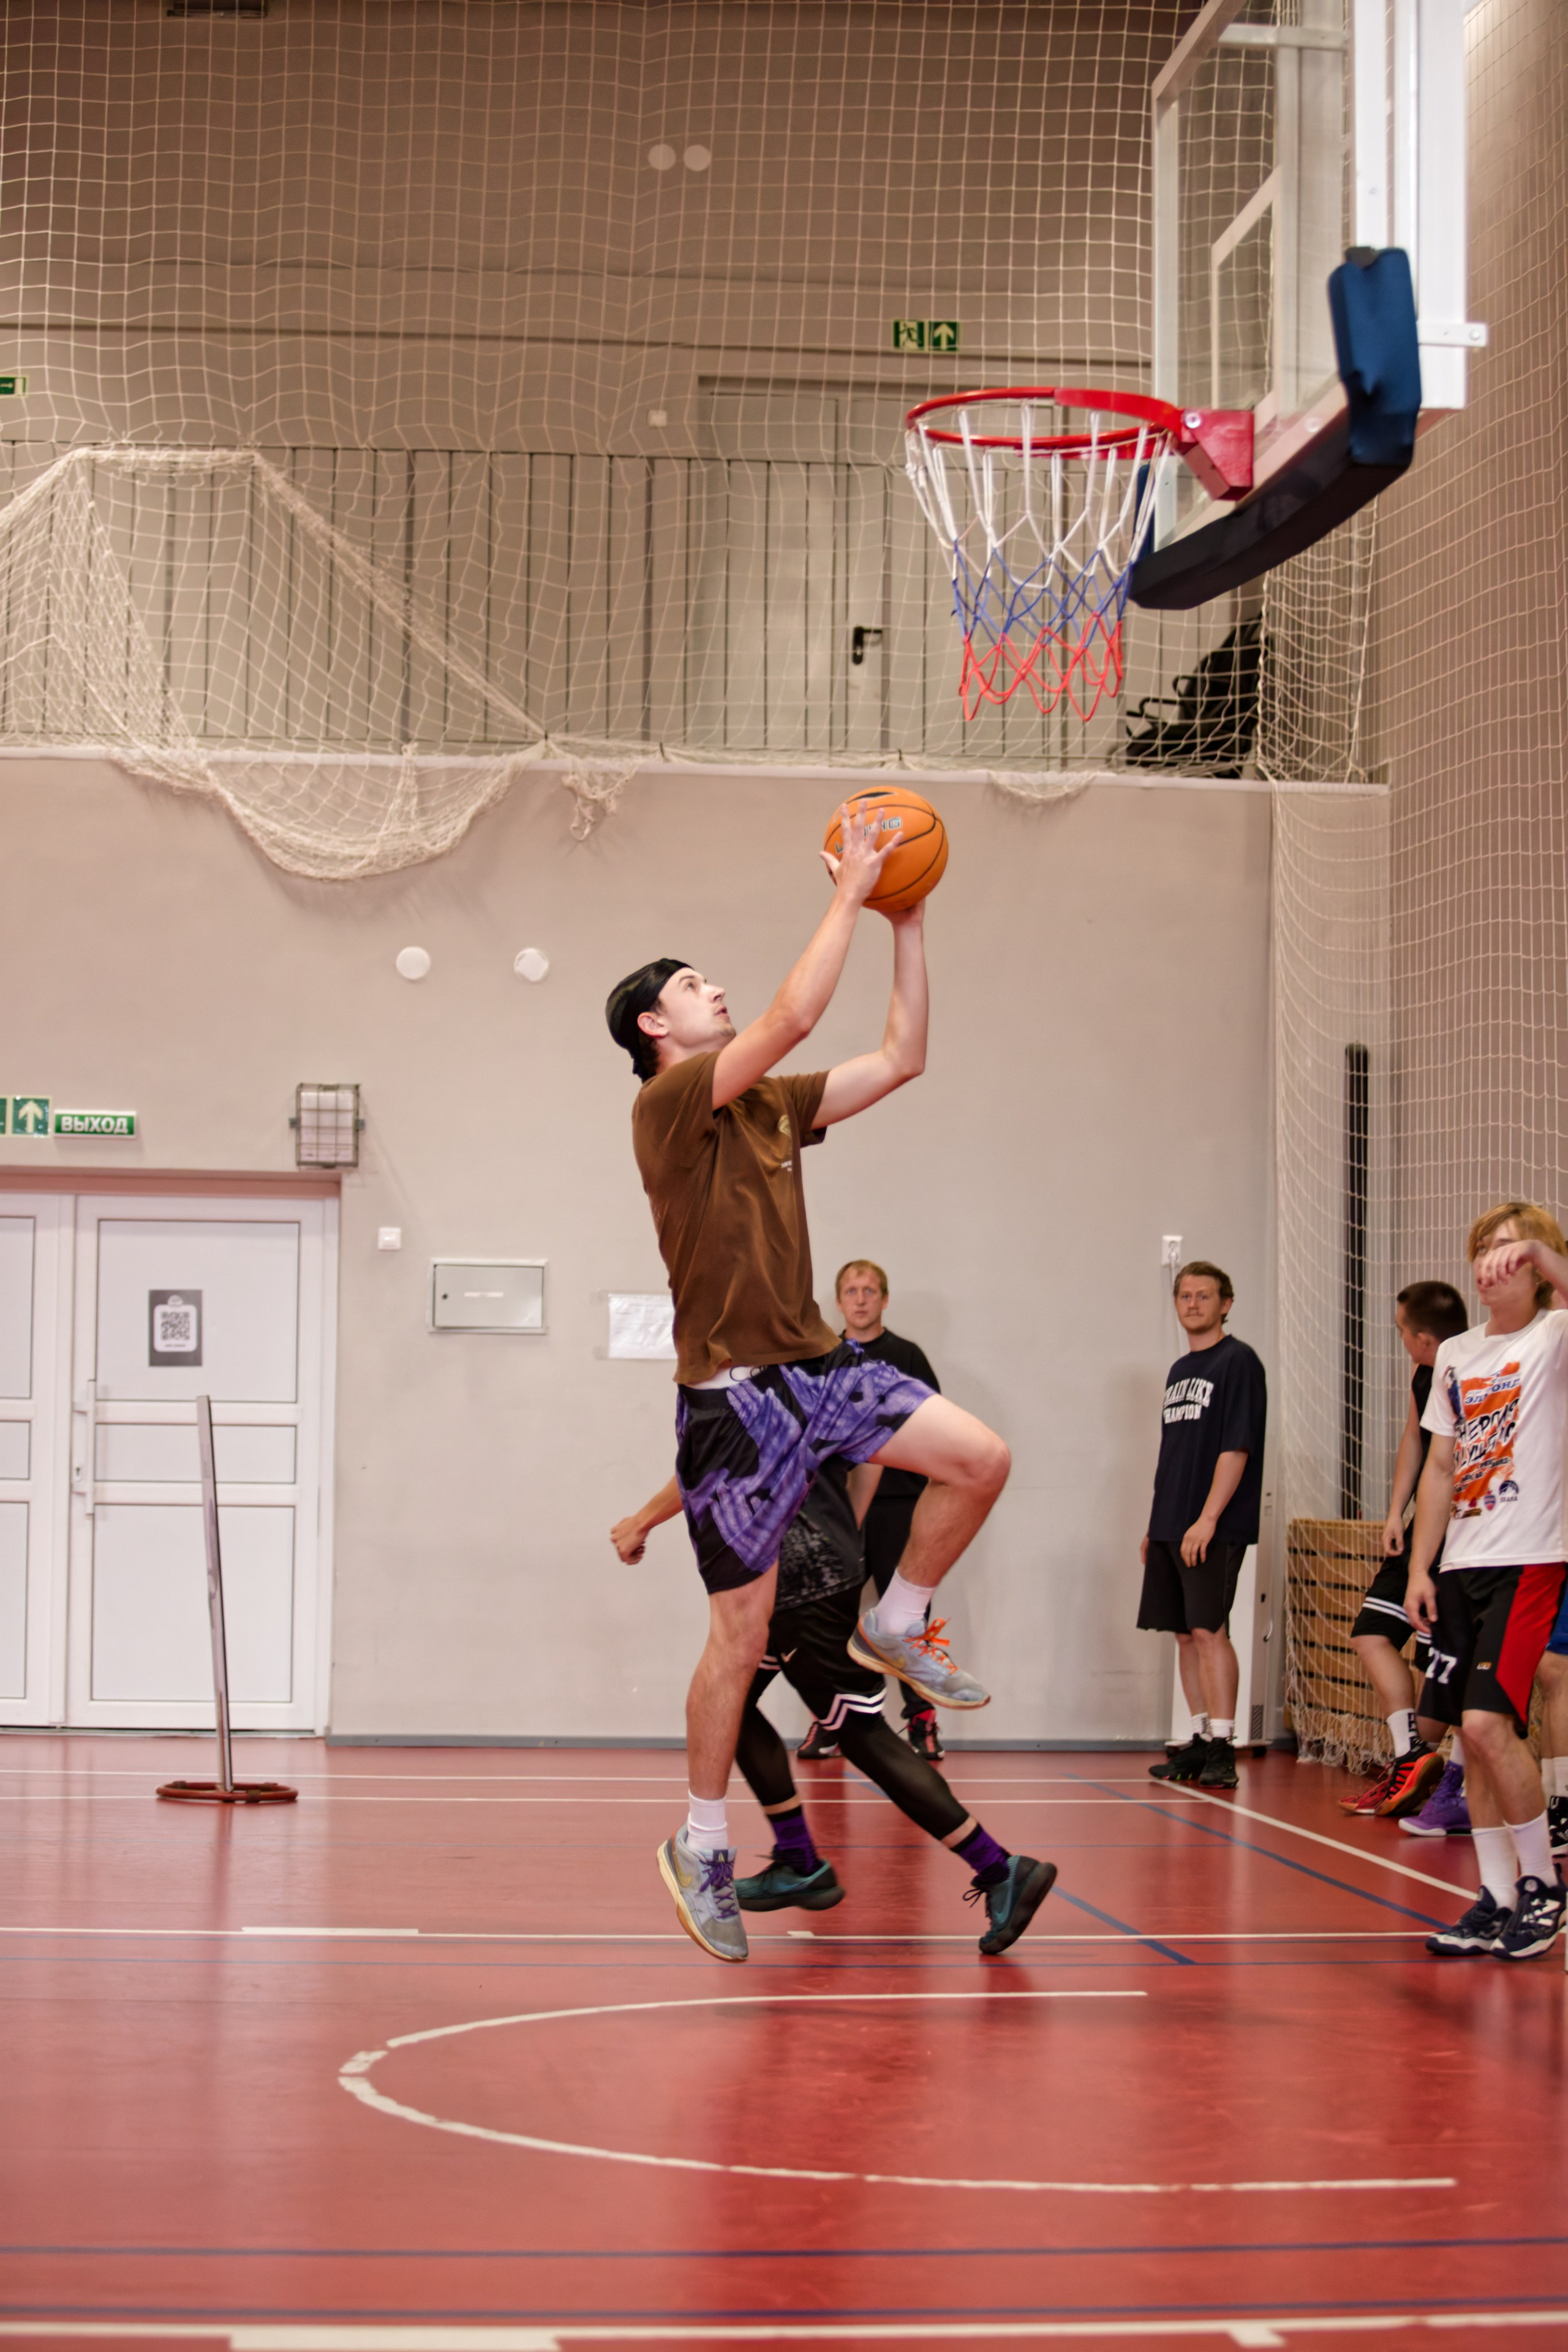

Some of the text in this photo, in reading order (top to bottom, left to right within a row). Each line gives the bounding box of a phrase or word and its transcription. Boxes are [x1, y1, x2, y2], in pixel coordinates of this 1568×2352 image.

[61, 1116, 128, 1133] ВЫХОД
[1186, 1378, 1213, 1408] LIKE
[1425, 1646, 1458, 1684] 77
